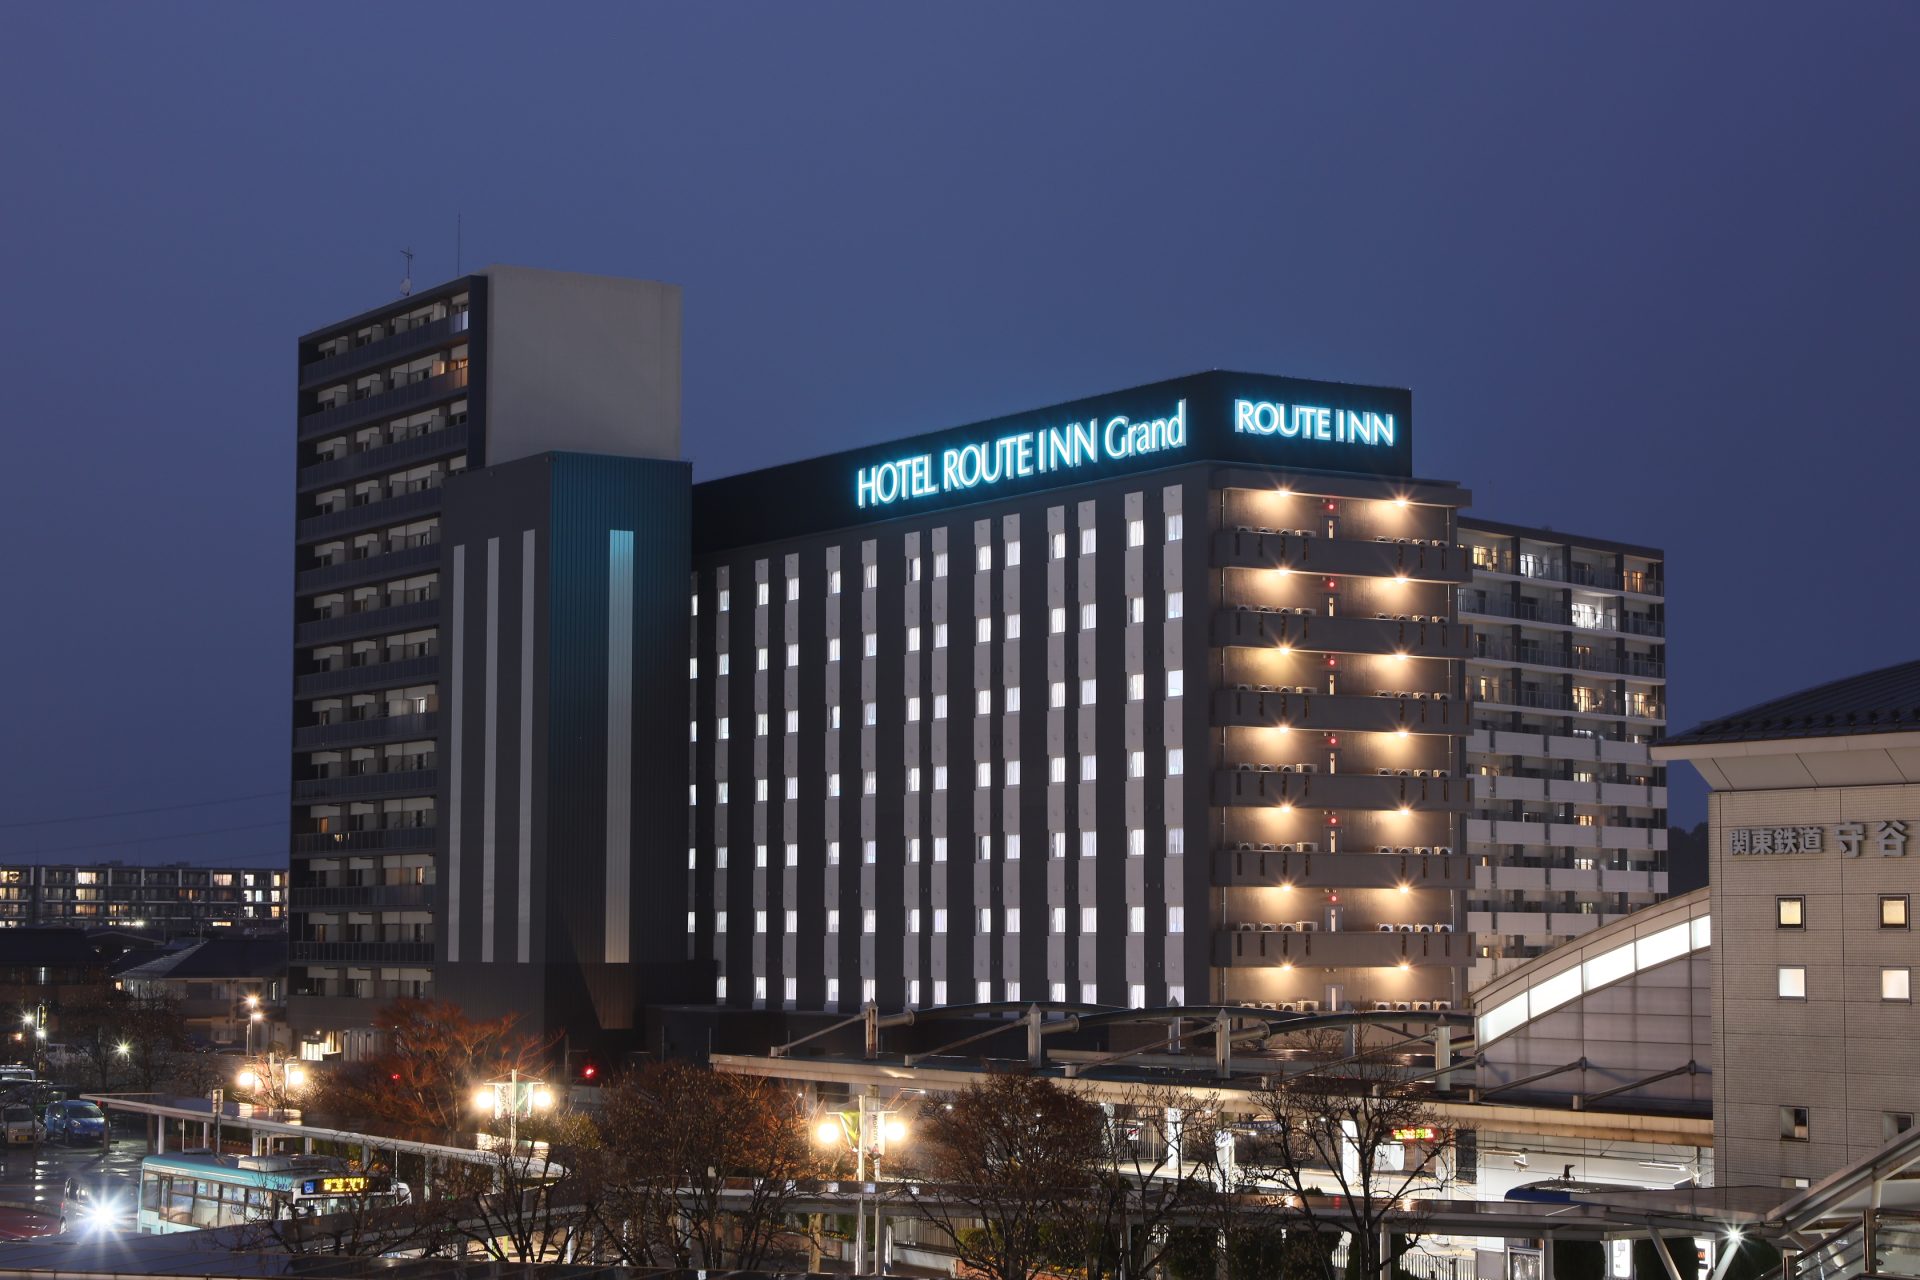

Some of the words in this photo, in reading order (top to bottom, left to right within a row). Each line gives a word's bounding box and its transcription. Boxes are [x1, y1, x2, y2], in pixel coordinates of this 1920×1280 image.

[1235, 399, 1331, 440] ROUTE
[1335, 409, 1394, 446] INN
[858, 454, 939, 509] HOTEL
[944, 432, 1034, 492] ROUTE
[1039, 418, 1098, 473] INN
[1105, 398, 1187, 459] Grand
[1730, 826, 1823, 856] 関東鉄道
[1833, 820, 1908, 858] 守谷
